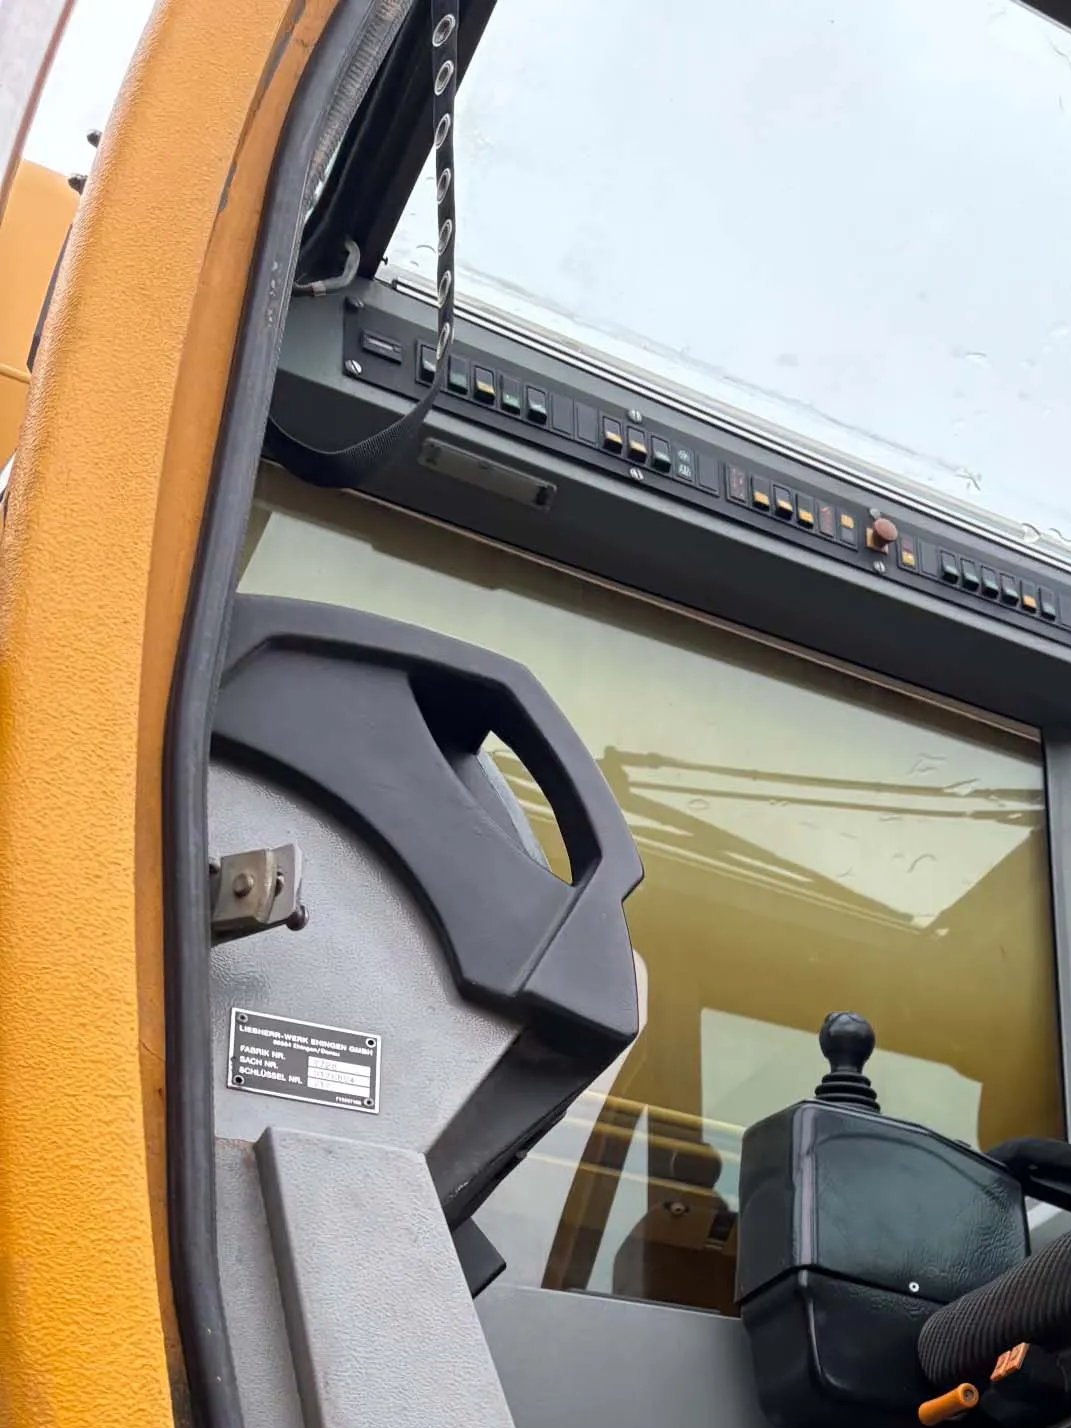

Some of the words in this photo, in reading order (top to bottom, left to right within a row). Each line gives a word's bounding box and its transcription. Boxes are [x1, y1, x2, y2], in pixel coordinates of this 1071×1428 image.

[240, 1044, 270, 1057] FABRIK
[271, 1049, 286, 1060] NR.
[263, 1059, 279, 1070] NR.
